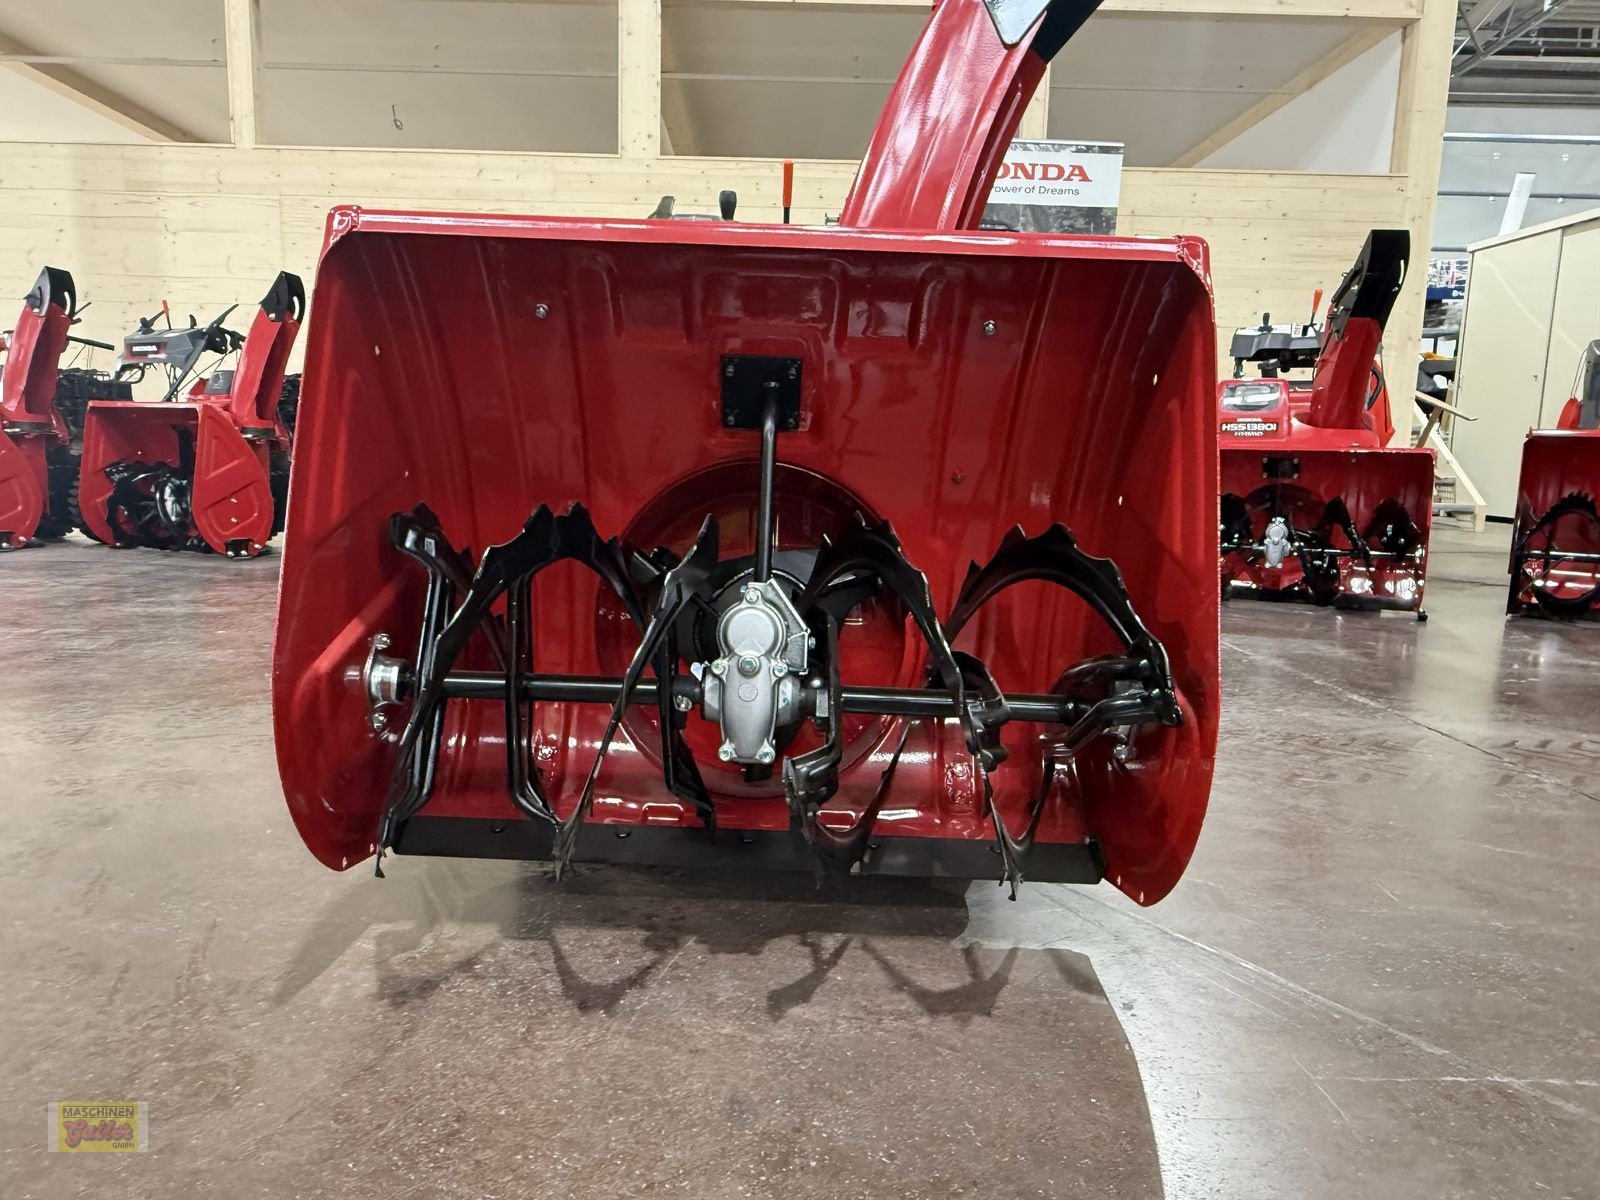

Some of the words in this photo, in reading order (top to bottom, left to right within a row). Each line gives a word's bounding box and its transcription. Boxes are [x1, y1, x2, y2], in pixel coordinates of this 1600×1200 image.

[996, 162, 1092, 182] ONDA
[993, 185, 1023, 194] ower
[1024, 185, 1036, 194] of
[1038, 185, 1080, 196] Dreams
